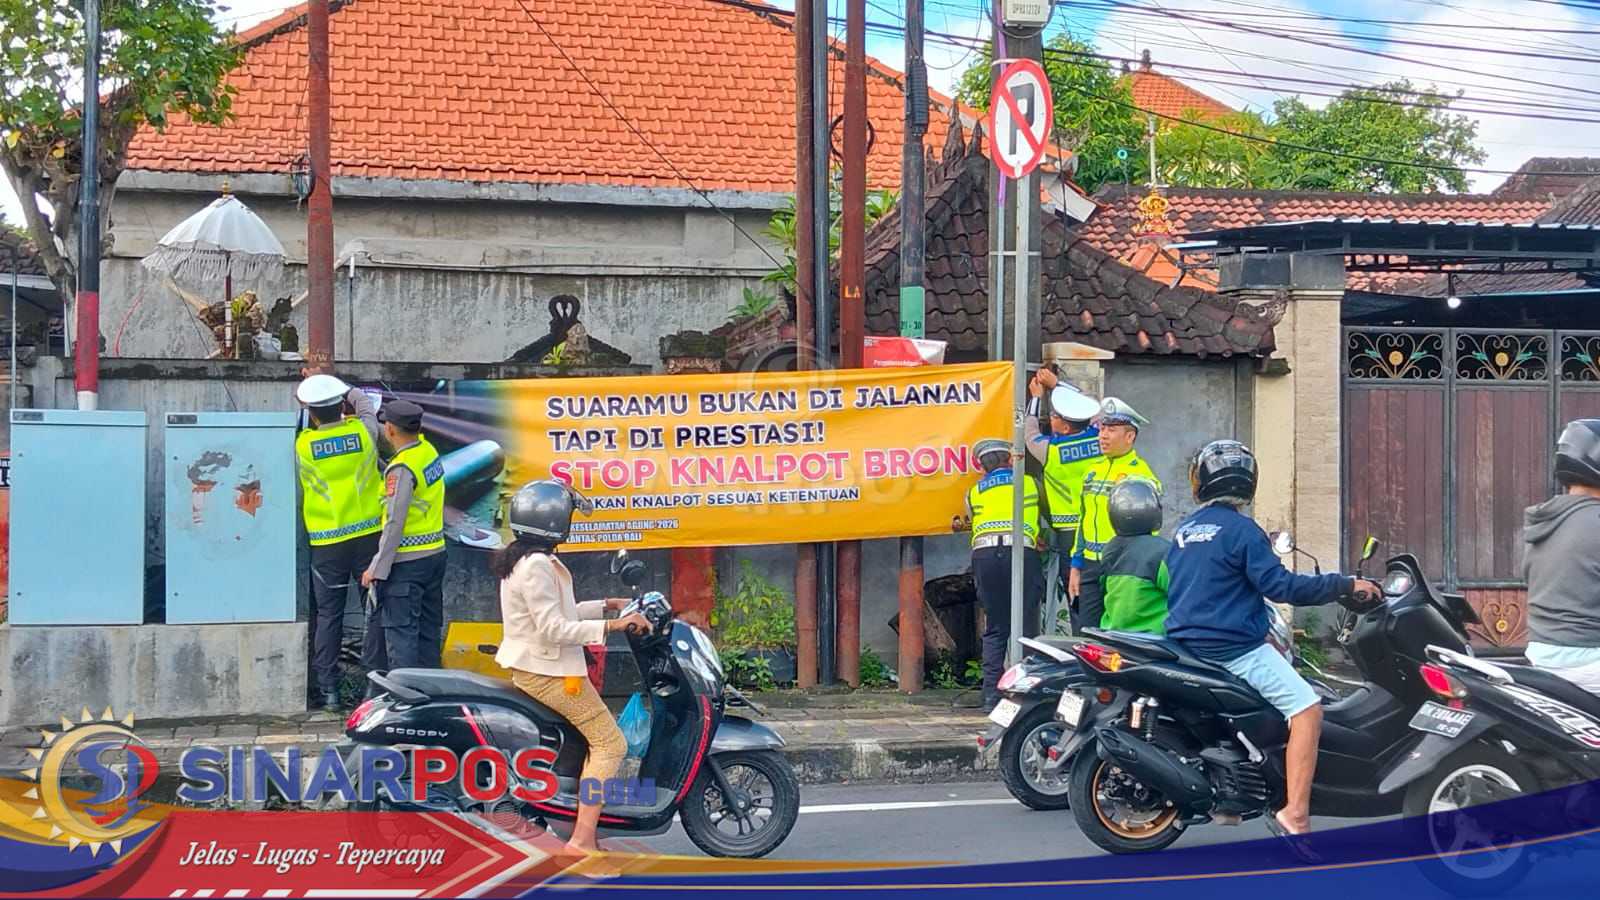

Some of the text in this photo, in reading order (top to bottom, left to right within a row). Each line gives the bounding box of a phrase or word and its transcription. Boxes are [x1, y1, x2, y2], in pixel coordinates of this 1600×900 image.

[1009, 83, 1035, 155] P
[547, 382, 982, 418] SUARAMU BUKAN DI JALANAN
[313, 437, 361, 457] POLISI
[549, 421, 825, 451] TAPI DI PRESTASI!
[1061, 442, 1099, 462] POLIS
[550, 458, 656, 489] STOP
[671, 451, 849, 486] KNALPOT
[632, 494, 702, 508] KNALPOT
[707, 491, 763, 506] SESUAI
[768, 487, 860, 503] KETENTUAN
[385, 726, 448, 738] SCOOPY
